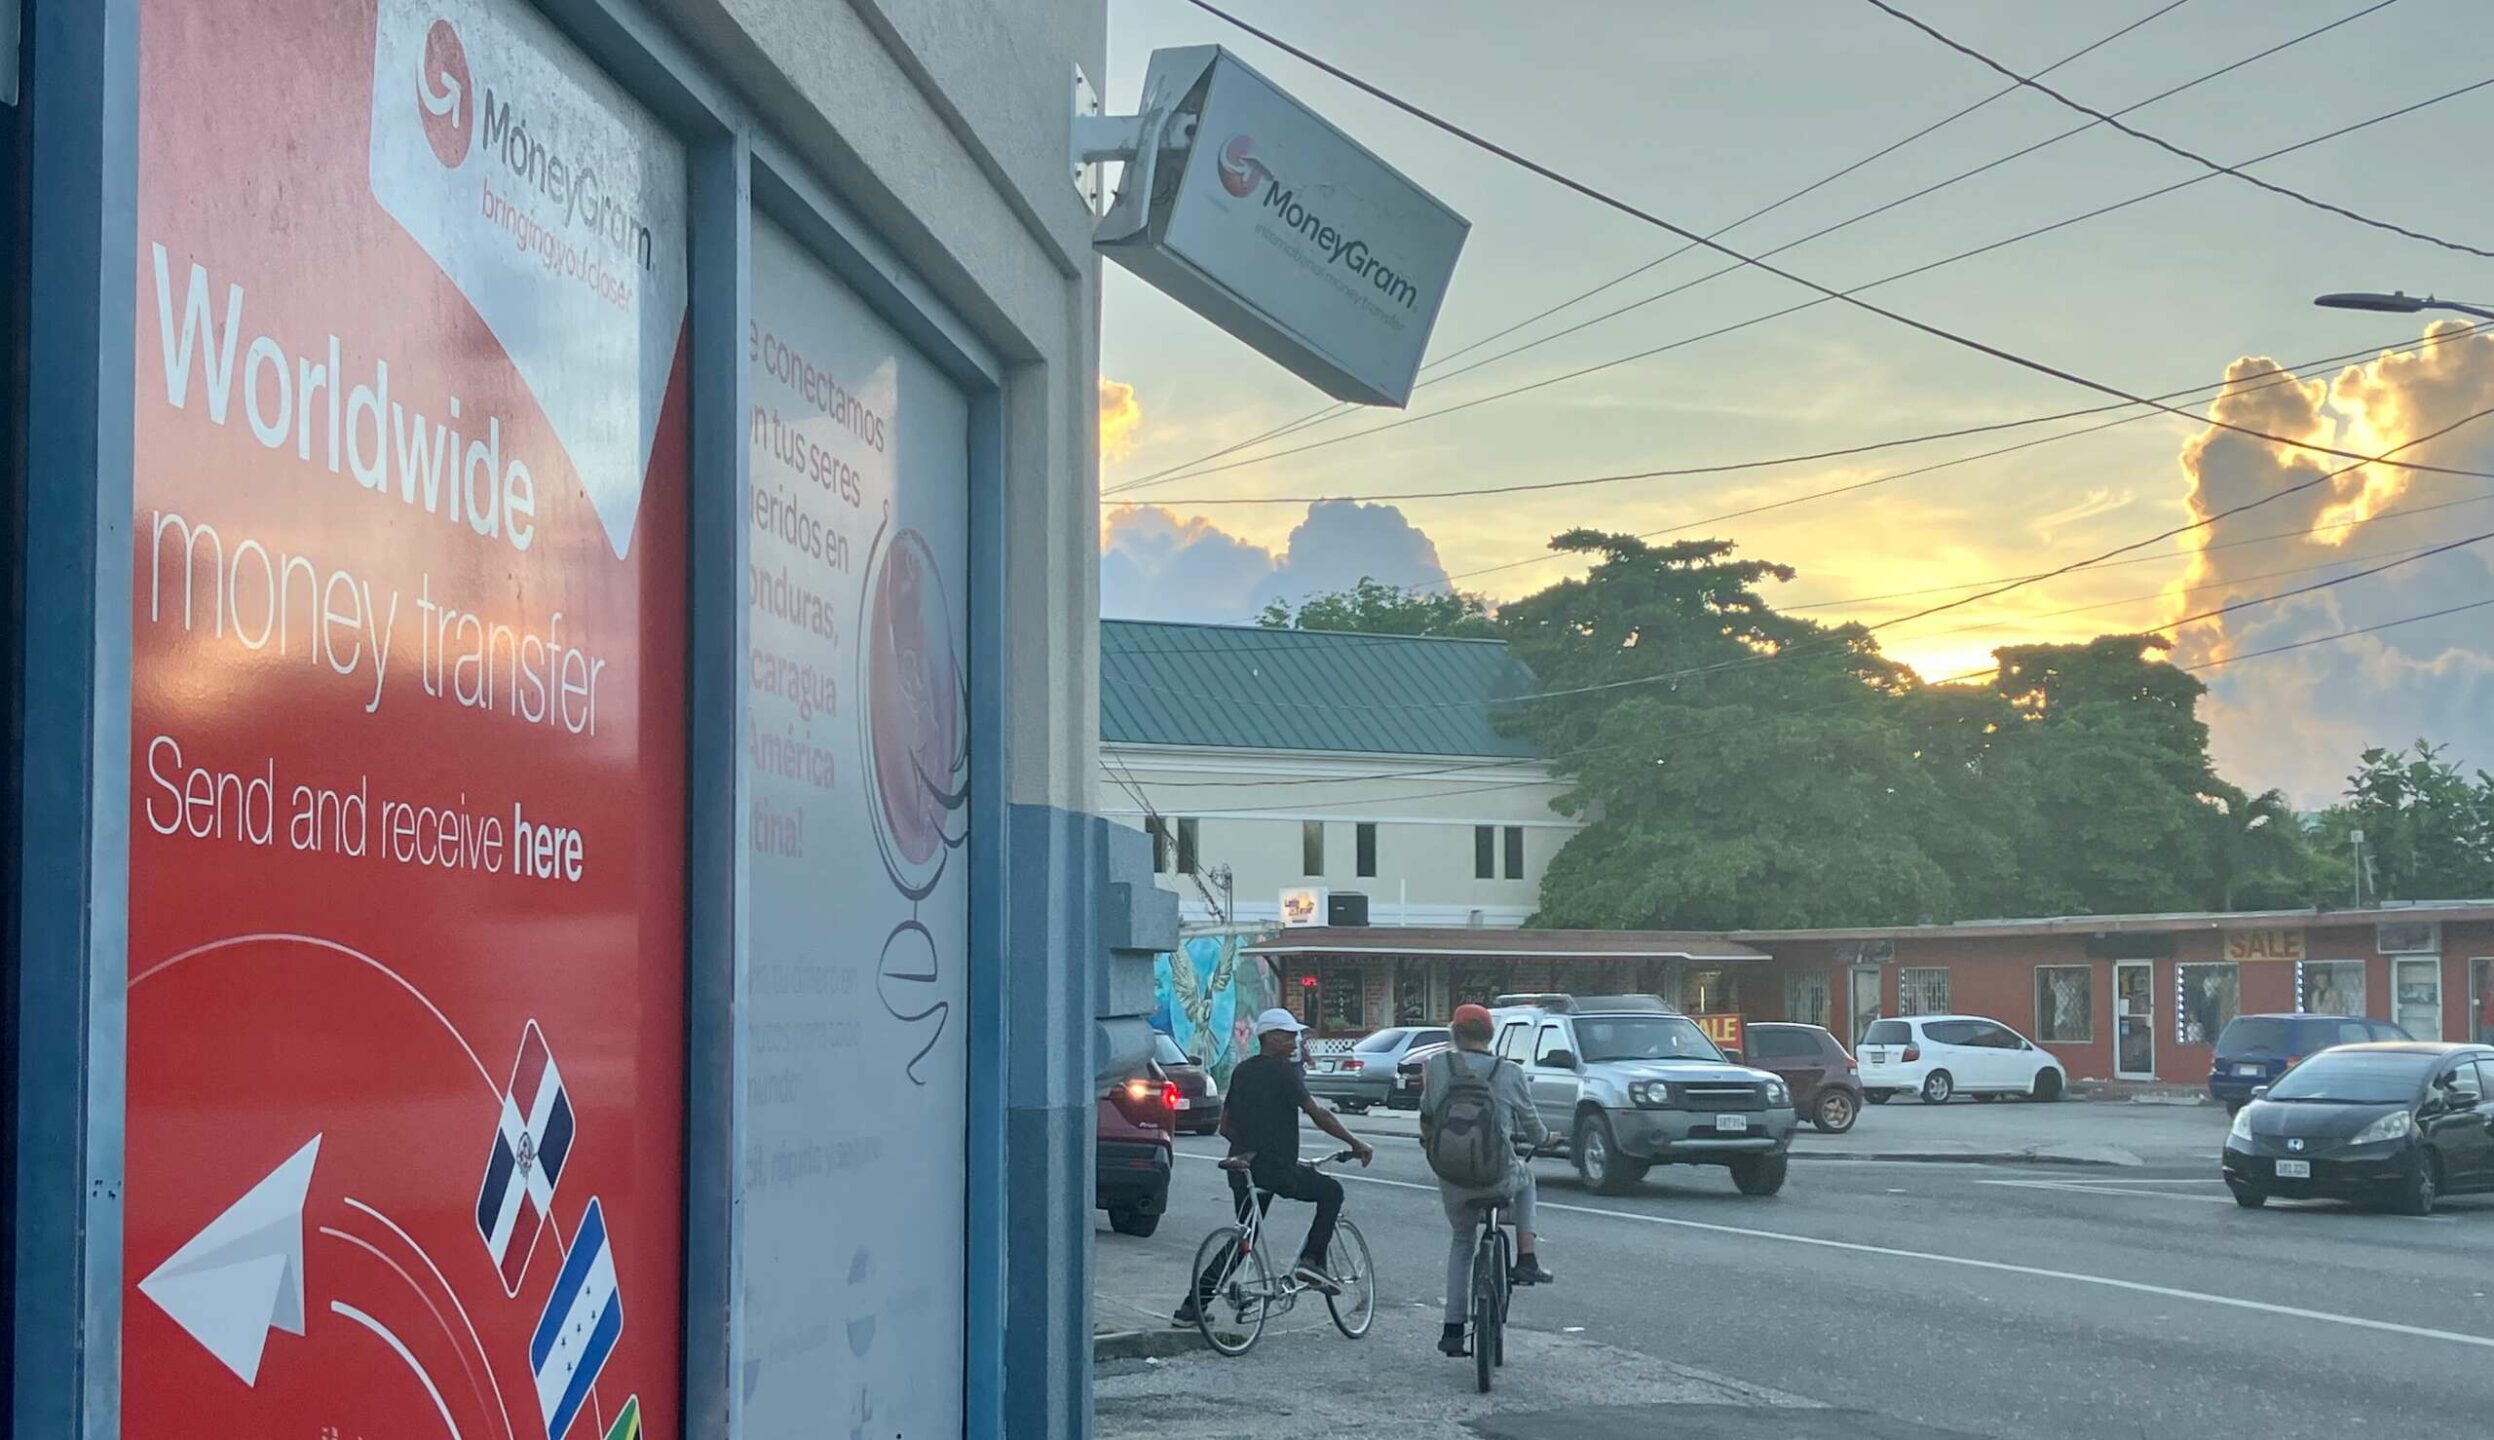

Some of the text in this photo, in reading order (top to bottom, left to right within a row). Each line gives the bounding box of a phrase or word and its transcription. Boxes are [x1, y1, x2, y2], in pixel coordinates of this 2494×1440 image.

[482, 87, 652, 272] MoneyGram
[1262, 179, 1418, 309] MoneyGram
[152, 240, 535, 552] Worldwide
[764, 332, 885, 453] conectamos
[773, 408, 806, 474] tus
[809, 442, 861, 508] seres
[825, 528, 850, 575] en
[152, 510, 605, 736] money transfer
[146, 735, 584, 882] Send and receive here
[2230, 932, 2301, 958] SALE
[1698, 1016, 1738, 1042] ALE
